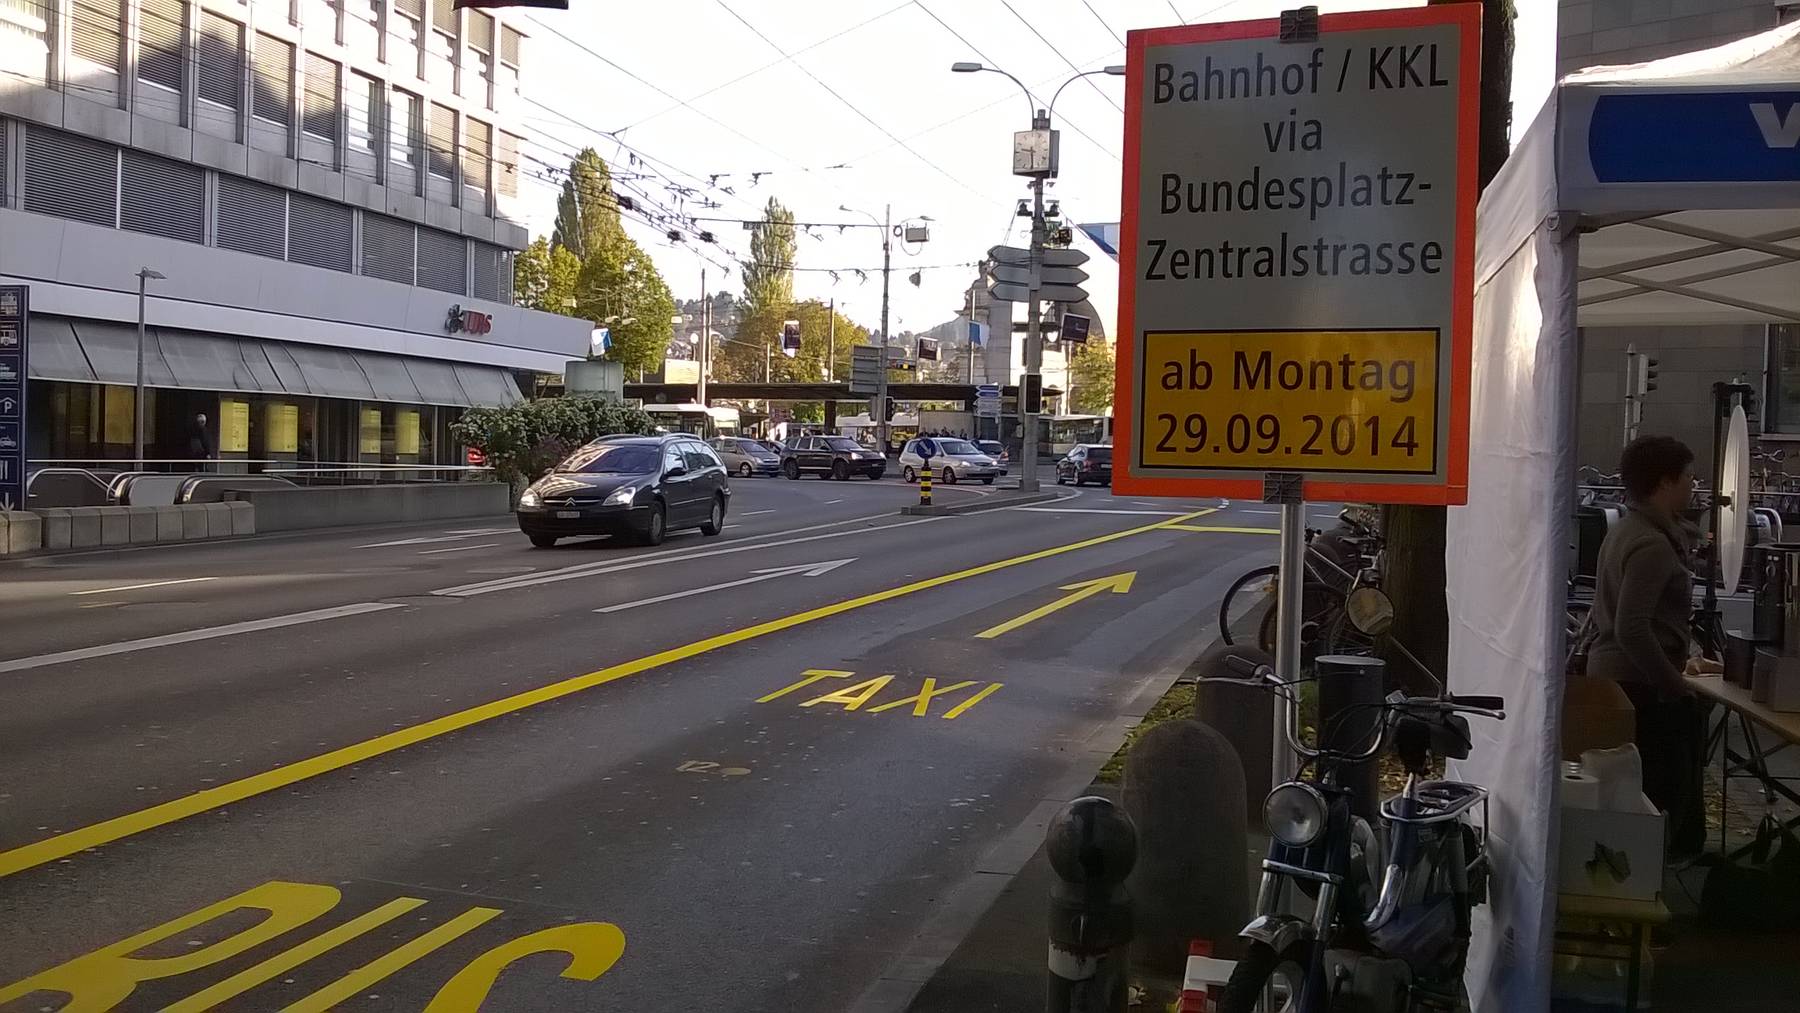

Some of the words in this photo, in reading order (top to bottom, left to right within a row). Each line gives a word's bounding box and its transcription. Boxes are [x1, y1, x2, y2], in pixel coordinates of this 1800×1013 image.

[1153, 47, 1325, 104] Bahnhof
[1337, 49, 1353, 93] /
[1369, 44, 1449, 90] KKL
[1264, 109, 1323, 153] via
[1160, 162, 1432, 220] Bundesplatz-
[1145, 233, 1443, 281] Zentralstrasse
[1161, 348, 1213, 391] ab
[1233, 351, 1416, 403] Montag
[1155, 413, 1420, 457] 29.09.2014
[755, 668, 1005, 720] TAXI
